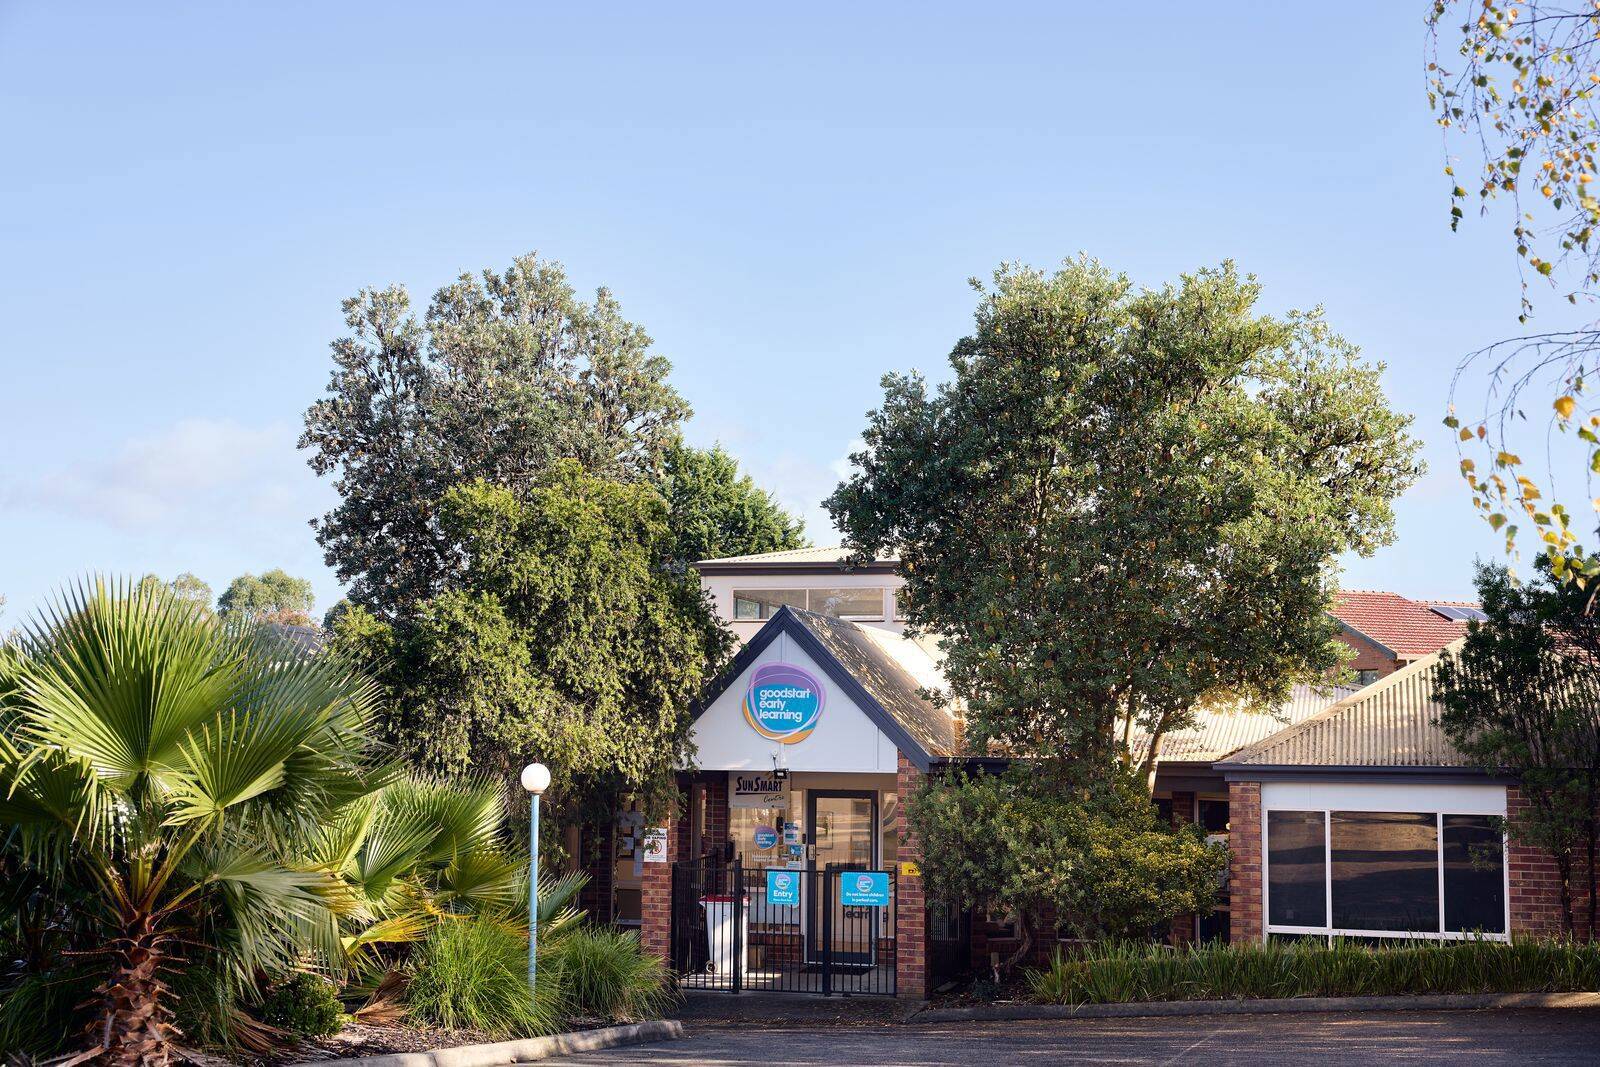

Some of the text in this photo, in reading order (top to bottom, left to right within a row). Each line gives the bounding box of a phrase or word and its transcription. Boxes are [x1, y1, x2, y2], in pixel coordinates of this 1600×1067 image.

[760, 688, 810, 700] goodstart
[759, 699, 786, 711] early
[760, 709, 803, 723] learning
[773, 890, 793, 899] Entry
